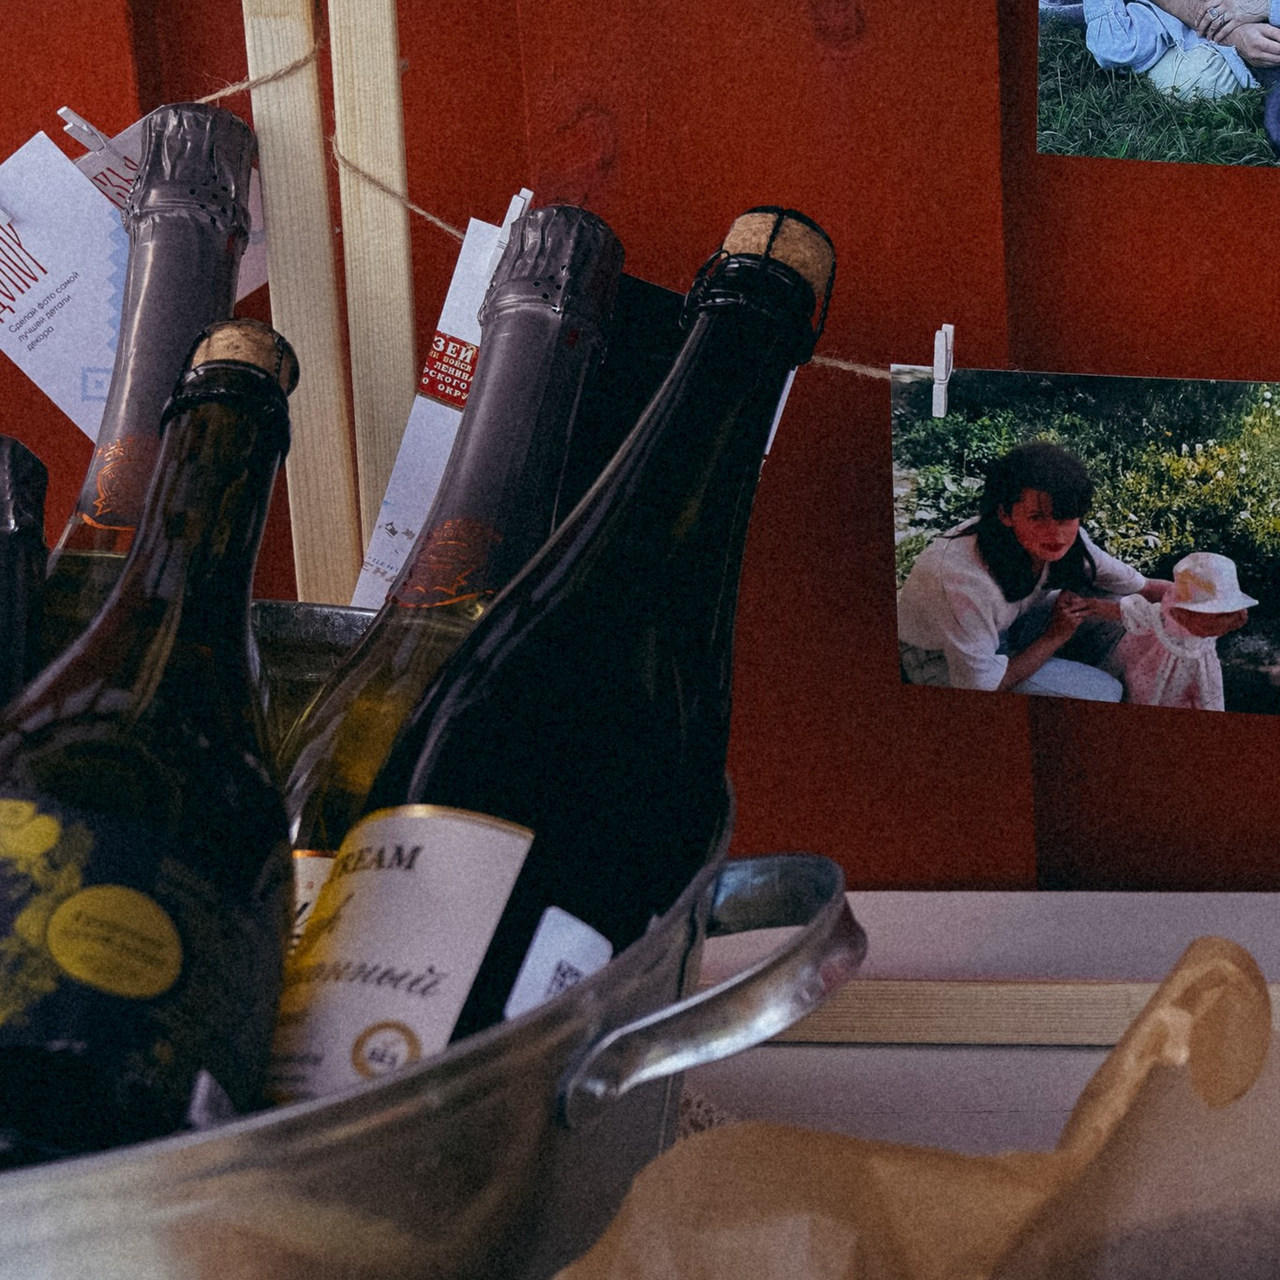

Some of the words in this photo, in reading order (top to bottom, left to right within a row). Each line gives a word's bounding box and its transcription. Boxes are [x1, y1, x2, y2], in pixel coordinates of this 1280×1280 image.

[8, 307, 38, 334] Сделай
[37, 292, 56, 310] фото
[55, 272, 80, 294] самой
[18, 317, 46, 342] лучшей
[45, 294, 72, 320] детали
[27, 326, 54, 352] декора
